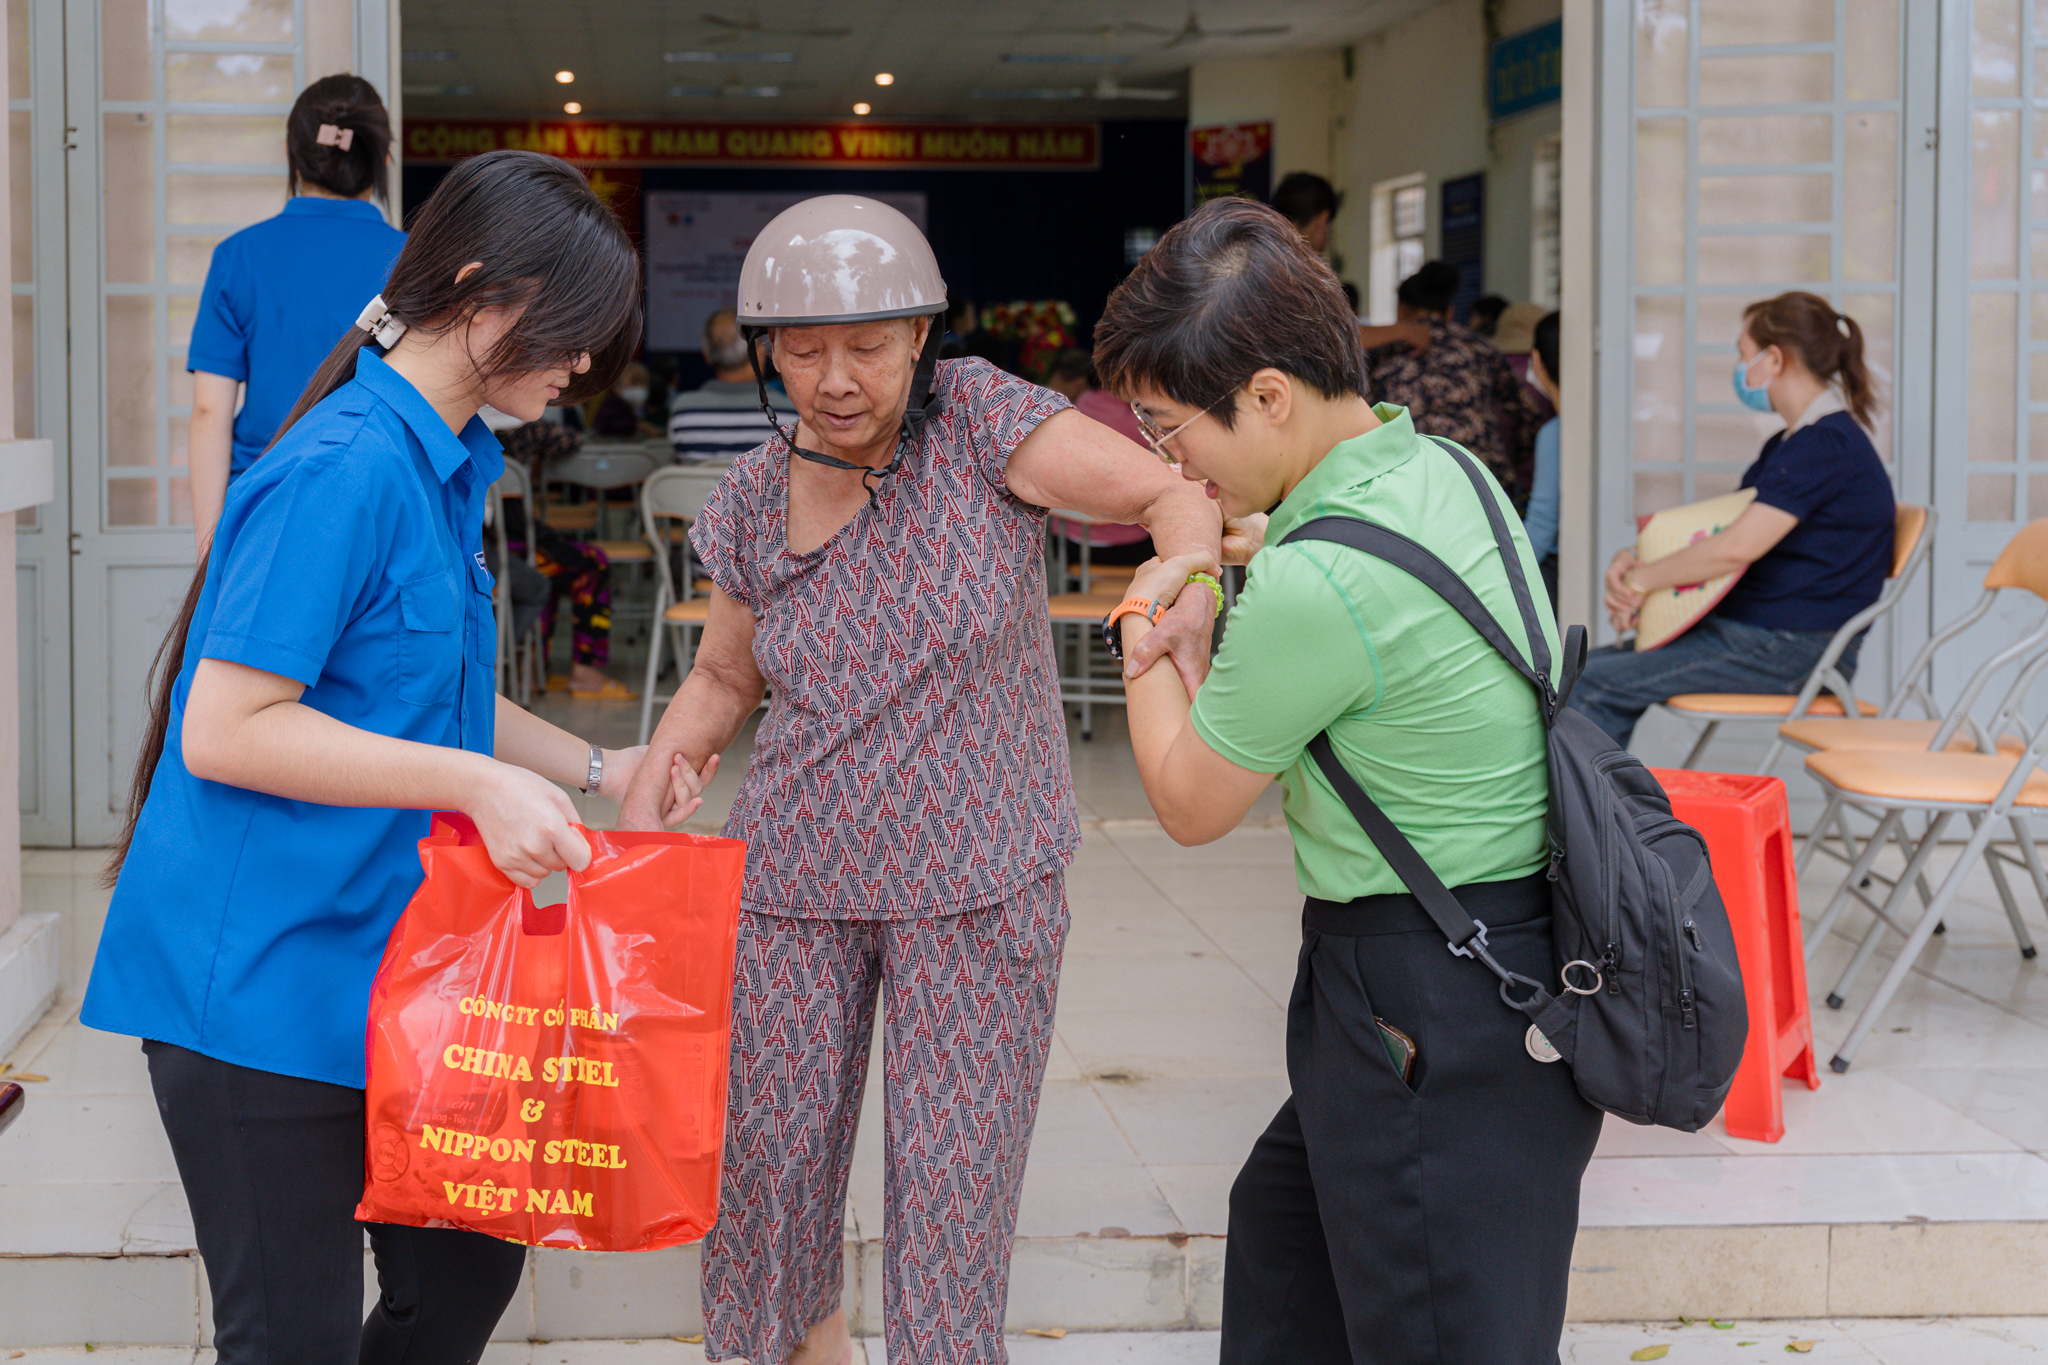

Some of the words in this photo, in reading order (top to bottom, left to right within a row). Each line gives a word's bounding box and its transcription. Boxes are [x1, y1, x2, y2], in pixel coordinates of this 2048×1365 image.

[572, 122, 644, 160] VIỆT
[652, 129, 720, 155] NAM
[726, 129, 834, 157] QUANG
[838, 129, 914, 158] VINH
[443, 1043, 533, 1082] CHINA
[520, 1098, 546, 1123] &
[419, 1124, 537, 1163] NIPPON
[543, 1138, 627, 1169] STEEL
[442, 1179, 518, 1216] VIỆT
[525, 1189, 594, 1218] NAM
